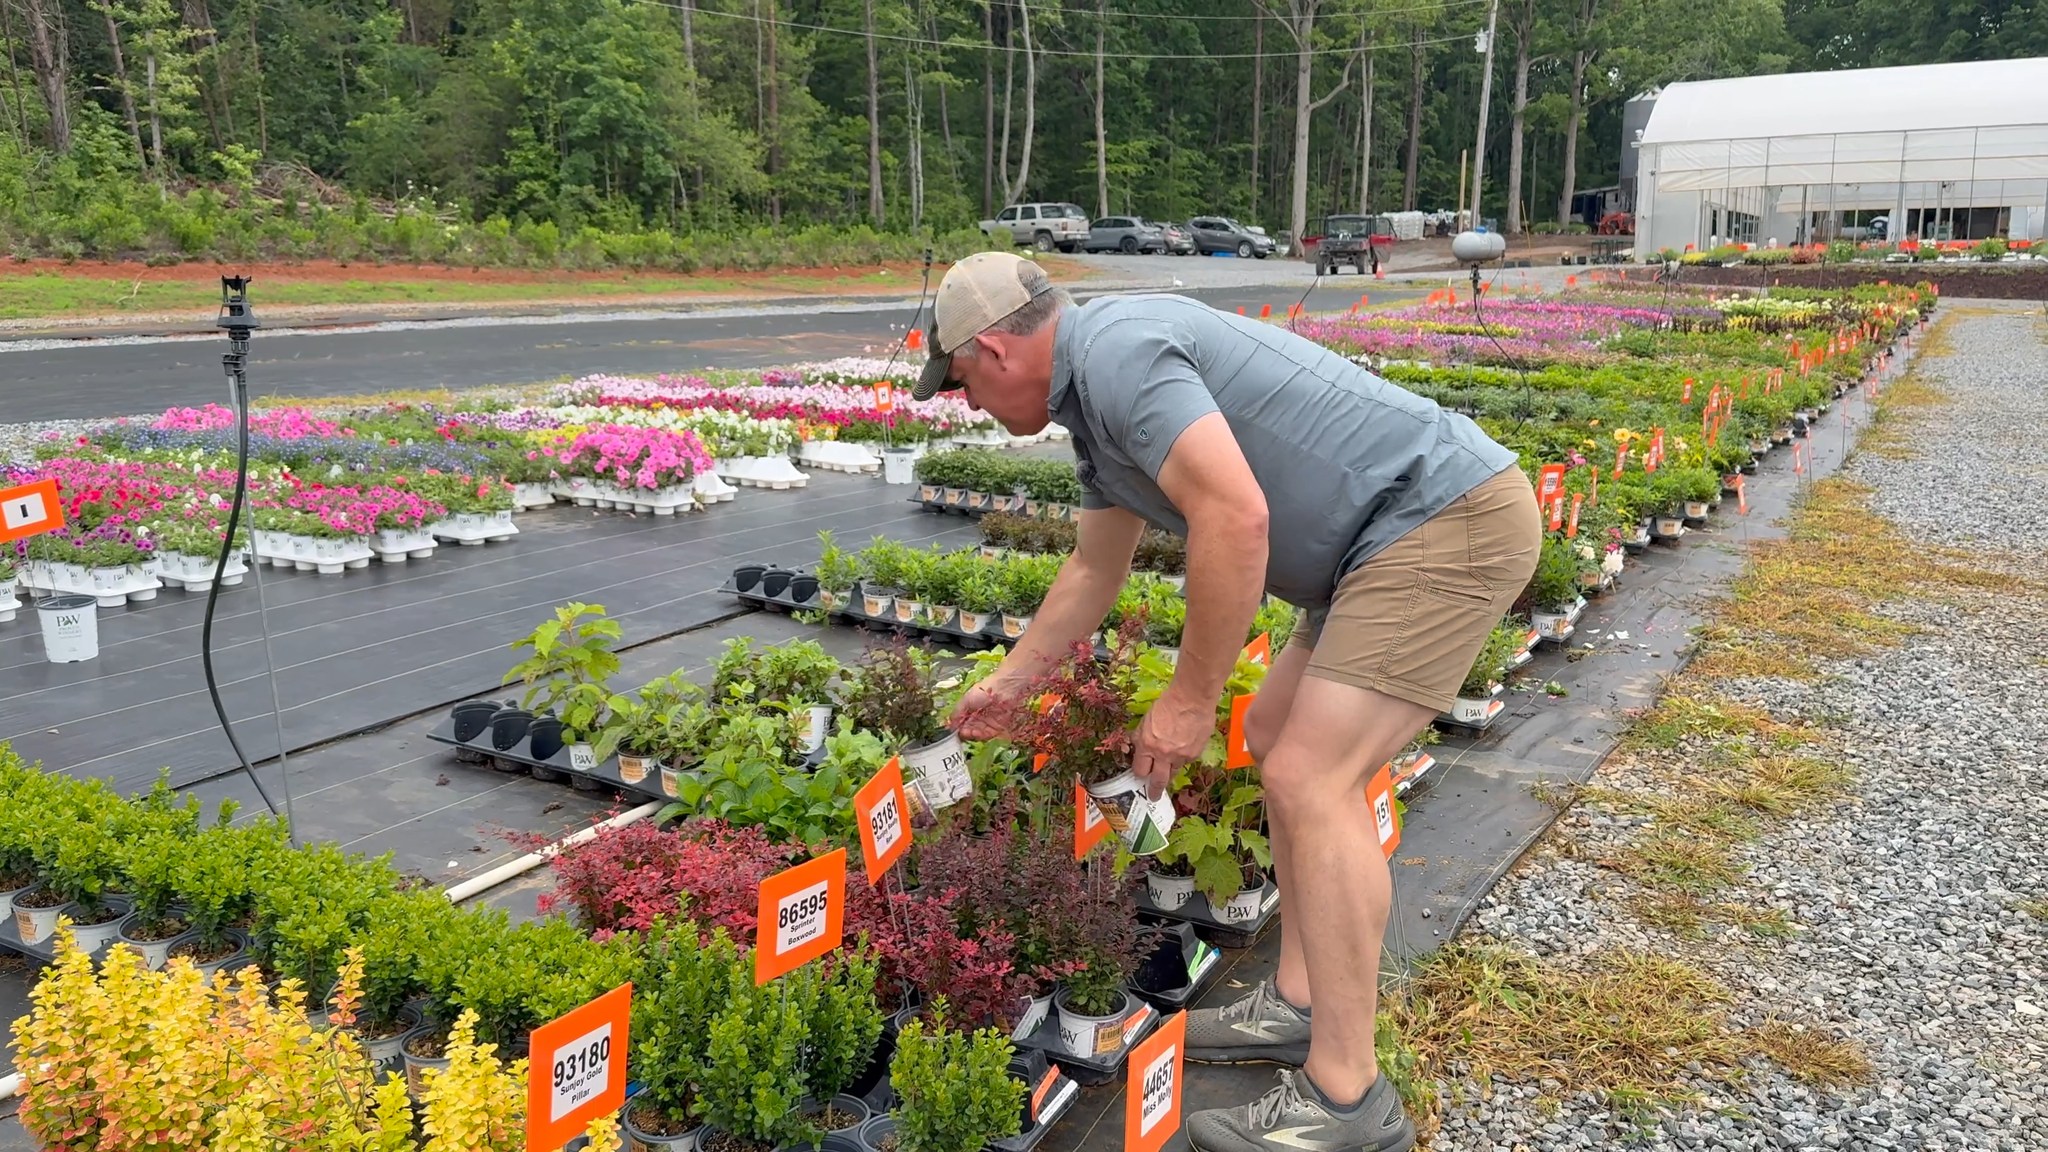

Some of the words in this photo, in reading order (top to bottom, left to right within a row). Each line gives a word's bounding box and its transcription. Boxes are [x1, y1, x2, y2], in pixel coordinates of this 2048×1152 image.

[56, 613, 81, 628] PW
[1465, 708, 1483, 718] PW
[871, 796, 898, 836] 93181
[778, 890, 828, 929] 86595
[1226, 904, 1253, 919] PW
[787, 926, 817, 946] Boxwood
[790, 917, 816, 933] Sprinter
[554, 1035, 611, 1088] 93180
[560, 1076, 585, 1096] Sunjoy
[586, 1064, 603, 1081] Gold
[1142, 1057, 1175, 1102] 44657
[571, 1087, 591, 1104] Pillar
[1142, 1101, 1157, 1121] Miss
[1157, 1084, 1172, 1107] Molly
